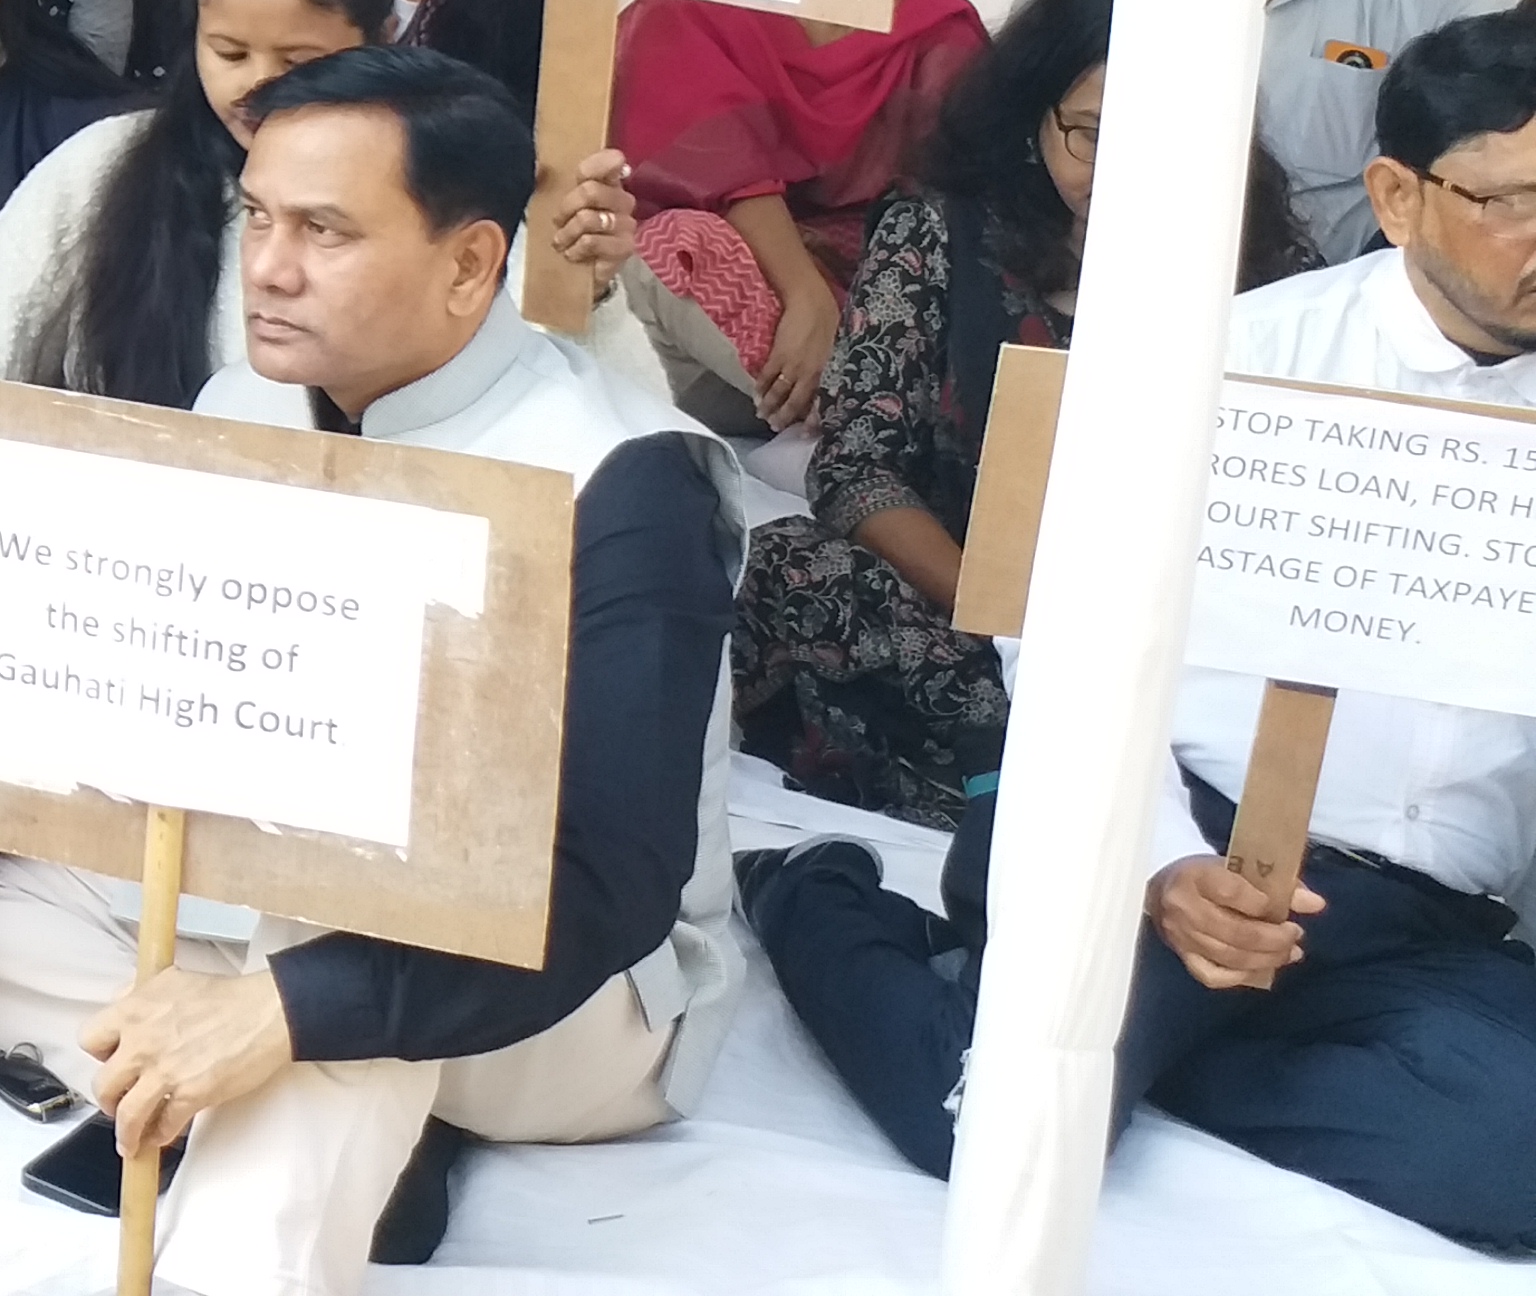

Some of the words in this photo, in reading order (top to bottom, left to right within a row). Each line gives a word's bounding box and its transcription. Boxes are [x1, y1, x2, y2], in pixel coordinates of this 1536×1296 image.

[1304, 419, 1429, 457] TAKING
[1441, 438, 1488, 465] RS.
[1211, 453, 1307, 488] RORES
[1318, 467, 1418, 508] LOAN,
[1432, 484, 1498, 514] FOR
[1207, 500, 1301, 533] OURT
[1308, 515, 1470, 558] SHIFTING.
[66, 548, 208, 602] strongly
[221, 577, 361, 621] oppose
[1197, 545, 1323, 584] ASTAGE
[1333, 565, 1378, 591] OF
[45, 602, 100, 638] the
[112, 616, 248, 673] shifting
[261, 644, 301, 673] of
[1289, 605, 1422, 645] MONEY.
[138, 683, 219, 729] High
